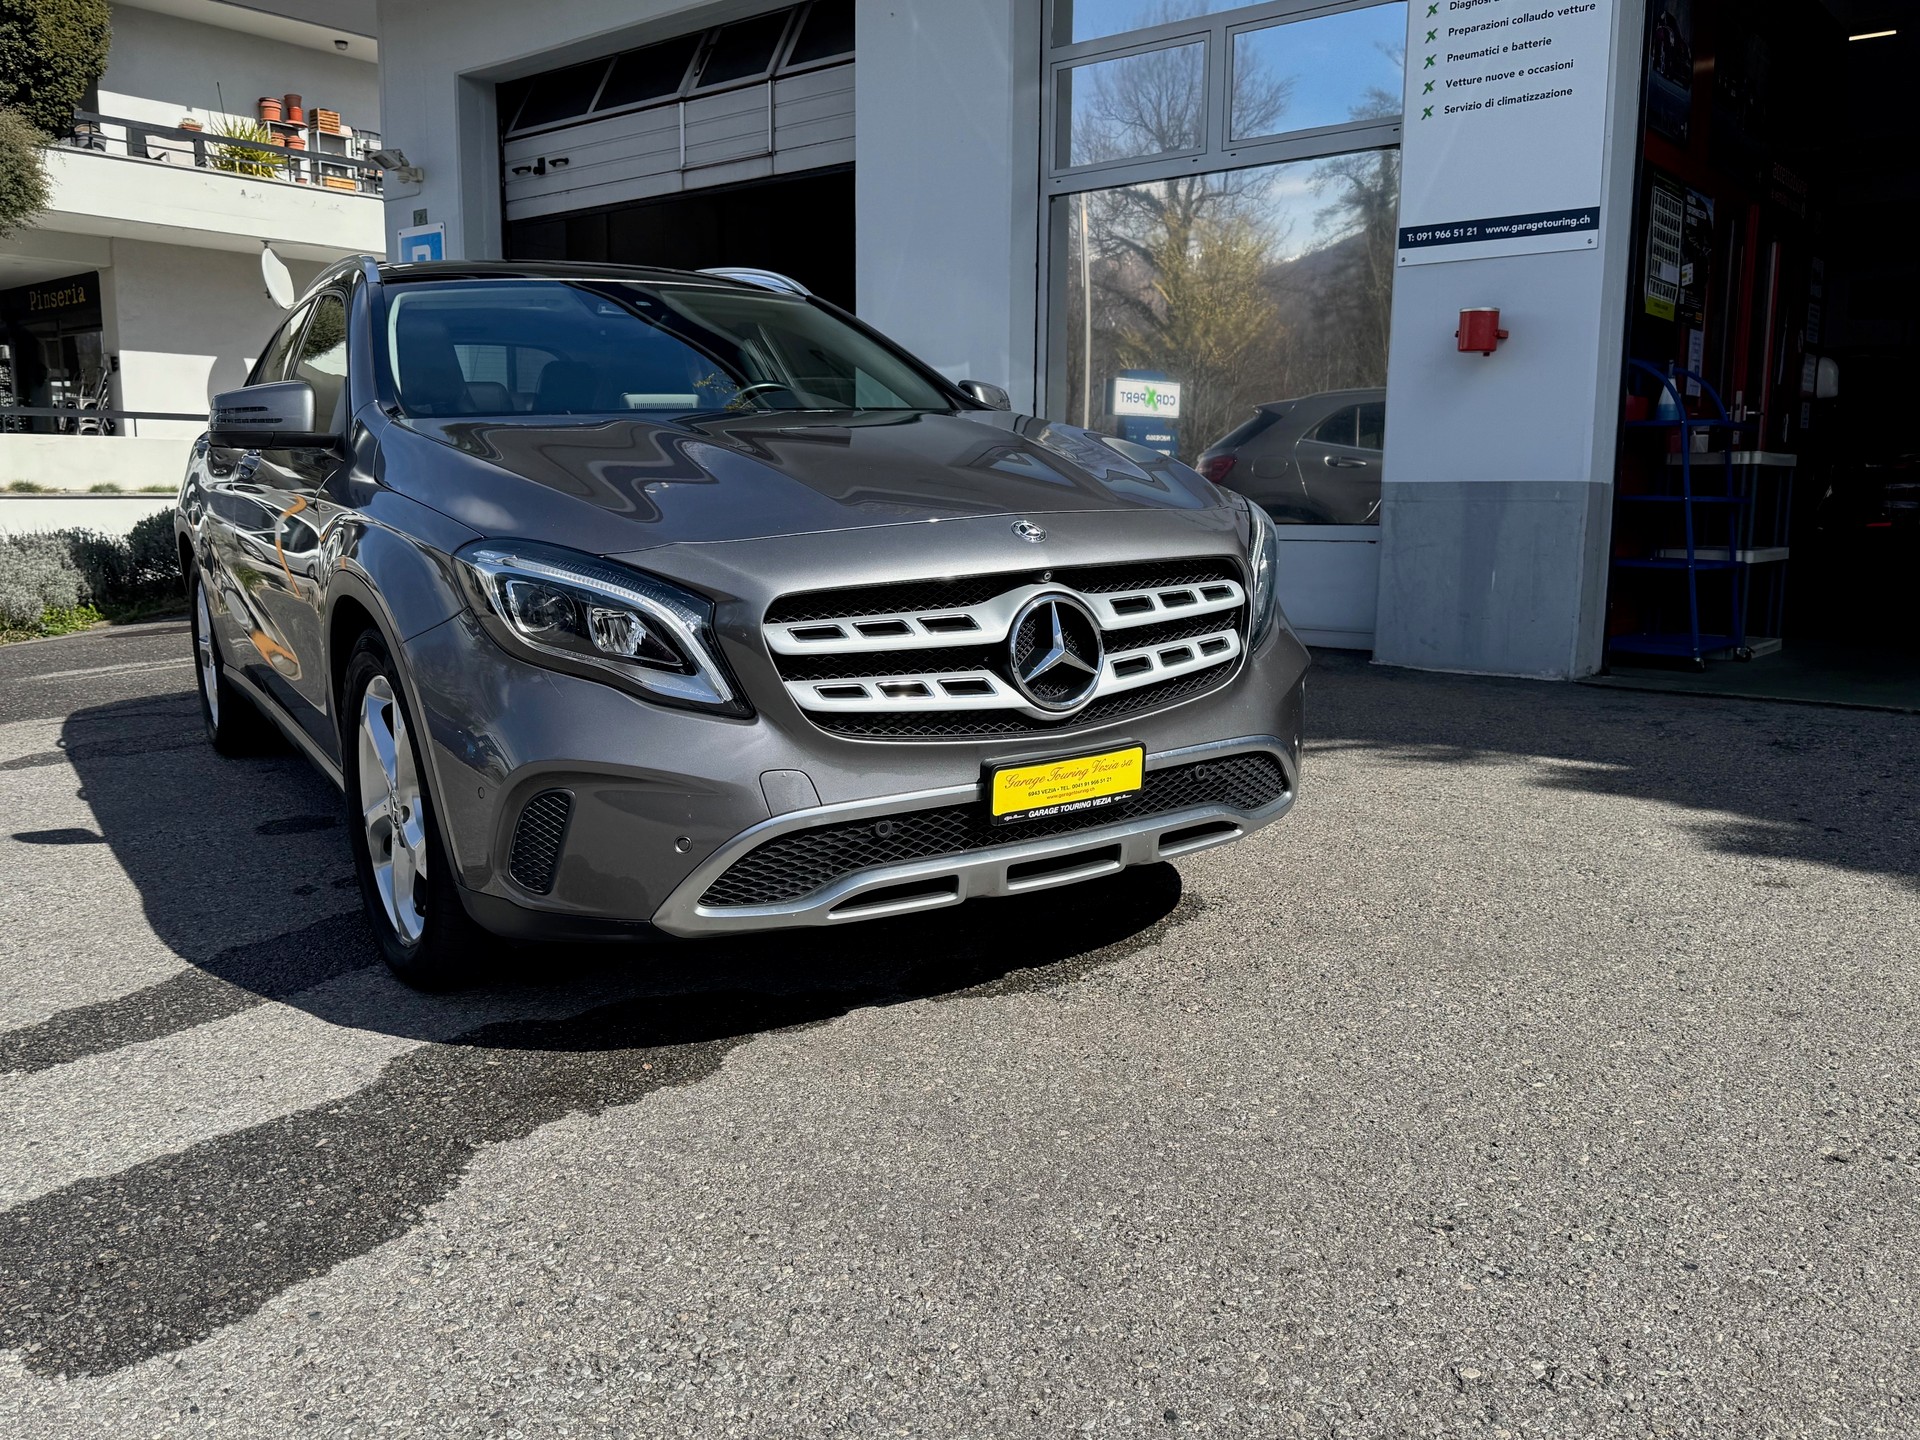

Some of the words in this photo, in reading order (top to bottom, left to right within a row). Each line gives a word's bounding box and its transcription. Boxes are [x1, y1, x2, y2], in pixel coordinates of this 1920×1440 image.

[1448, 17, 1509, 37] Preparazioni
[1512, 10, 1554, 25] collaudo
[1557, 2, 1596, 17] vetture
[1447, 45, 1500, 63] Pneumatici
[1502, 44, 1509, 53] e
[1512, 36, 1552, 52] batterie
[1446, 74, 1483, 89] Vetture
[1485, 70, 1516, 82] nuove
[1518, 69, 1525, 77] e
[1527, 59, 1574, 76] occasioni
[1444, 99, 1482, 115] Servizio
[1485, 98, 1495, 108] di
[1497, 87, 1573, 107] climatizzazione
[1407, 233, 1415, 242] T:
[1416, 233, 1432, 241] 091
[1435, 230, 1451, 239] 966
[1453, 229, 1464, 238] 51
[1466, 227, 1478, 236] 21
[1485, 215, 1590, 234] www.garagetouring.ch
[29, 283, 87, 311] Pinseria
[1004, 774, 1046, 789] Garage
[1047, 767, 1089, 782] Touring
[1091, 758, 1119, 774] Vezia
[1121, 758, 1134, 768] sa
[1028, 807, 1059, 818] GARAGE
[1060, 801, 1091, 813] TOURING
[1092, 796, 1112, 807] VEZIA
